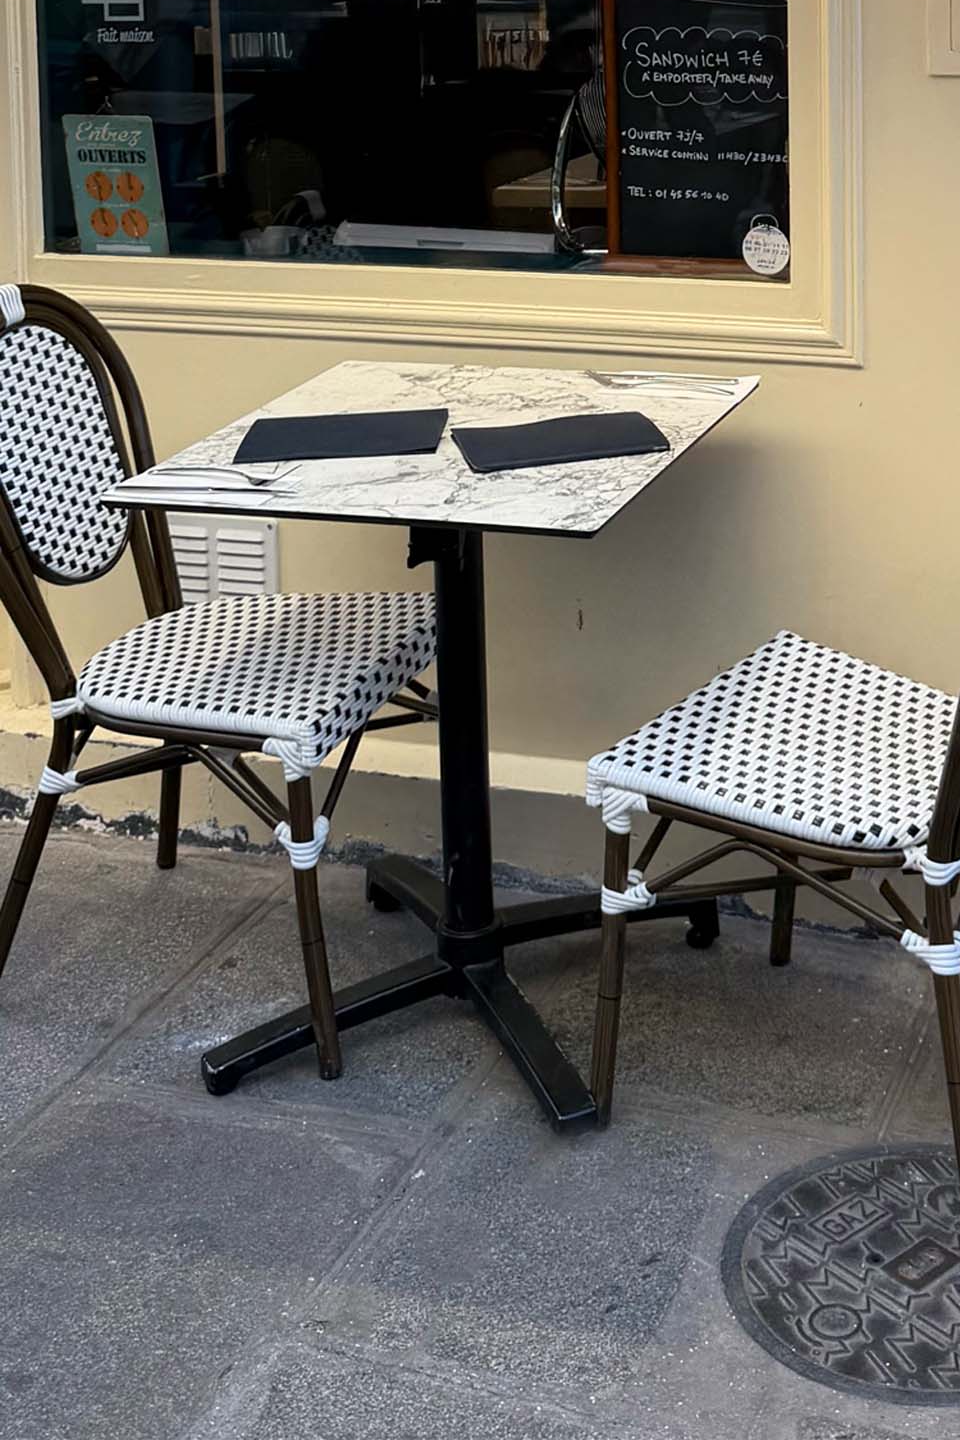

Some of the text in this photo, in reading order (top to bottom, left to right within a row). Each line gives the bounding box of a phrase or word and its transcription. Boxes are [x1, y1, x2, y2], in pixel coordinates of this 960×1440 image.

[97, 27, 155, 44] Fait maison
[635, 42, 763, 68] SANDWICH 7€
[75, 121, 142, 147] Entrez
[627, 128, 672, 141] OUVERT
[77, 148, 147, 164] OUVERTS
[629, 145, 669, 159] SERVICE
[655, 189, 667, 200] 01
[670, 190, 683, 200] 45
[715, 191, 729, 201] 40
[822, 1199, 879, 1236] GAZ
